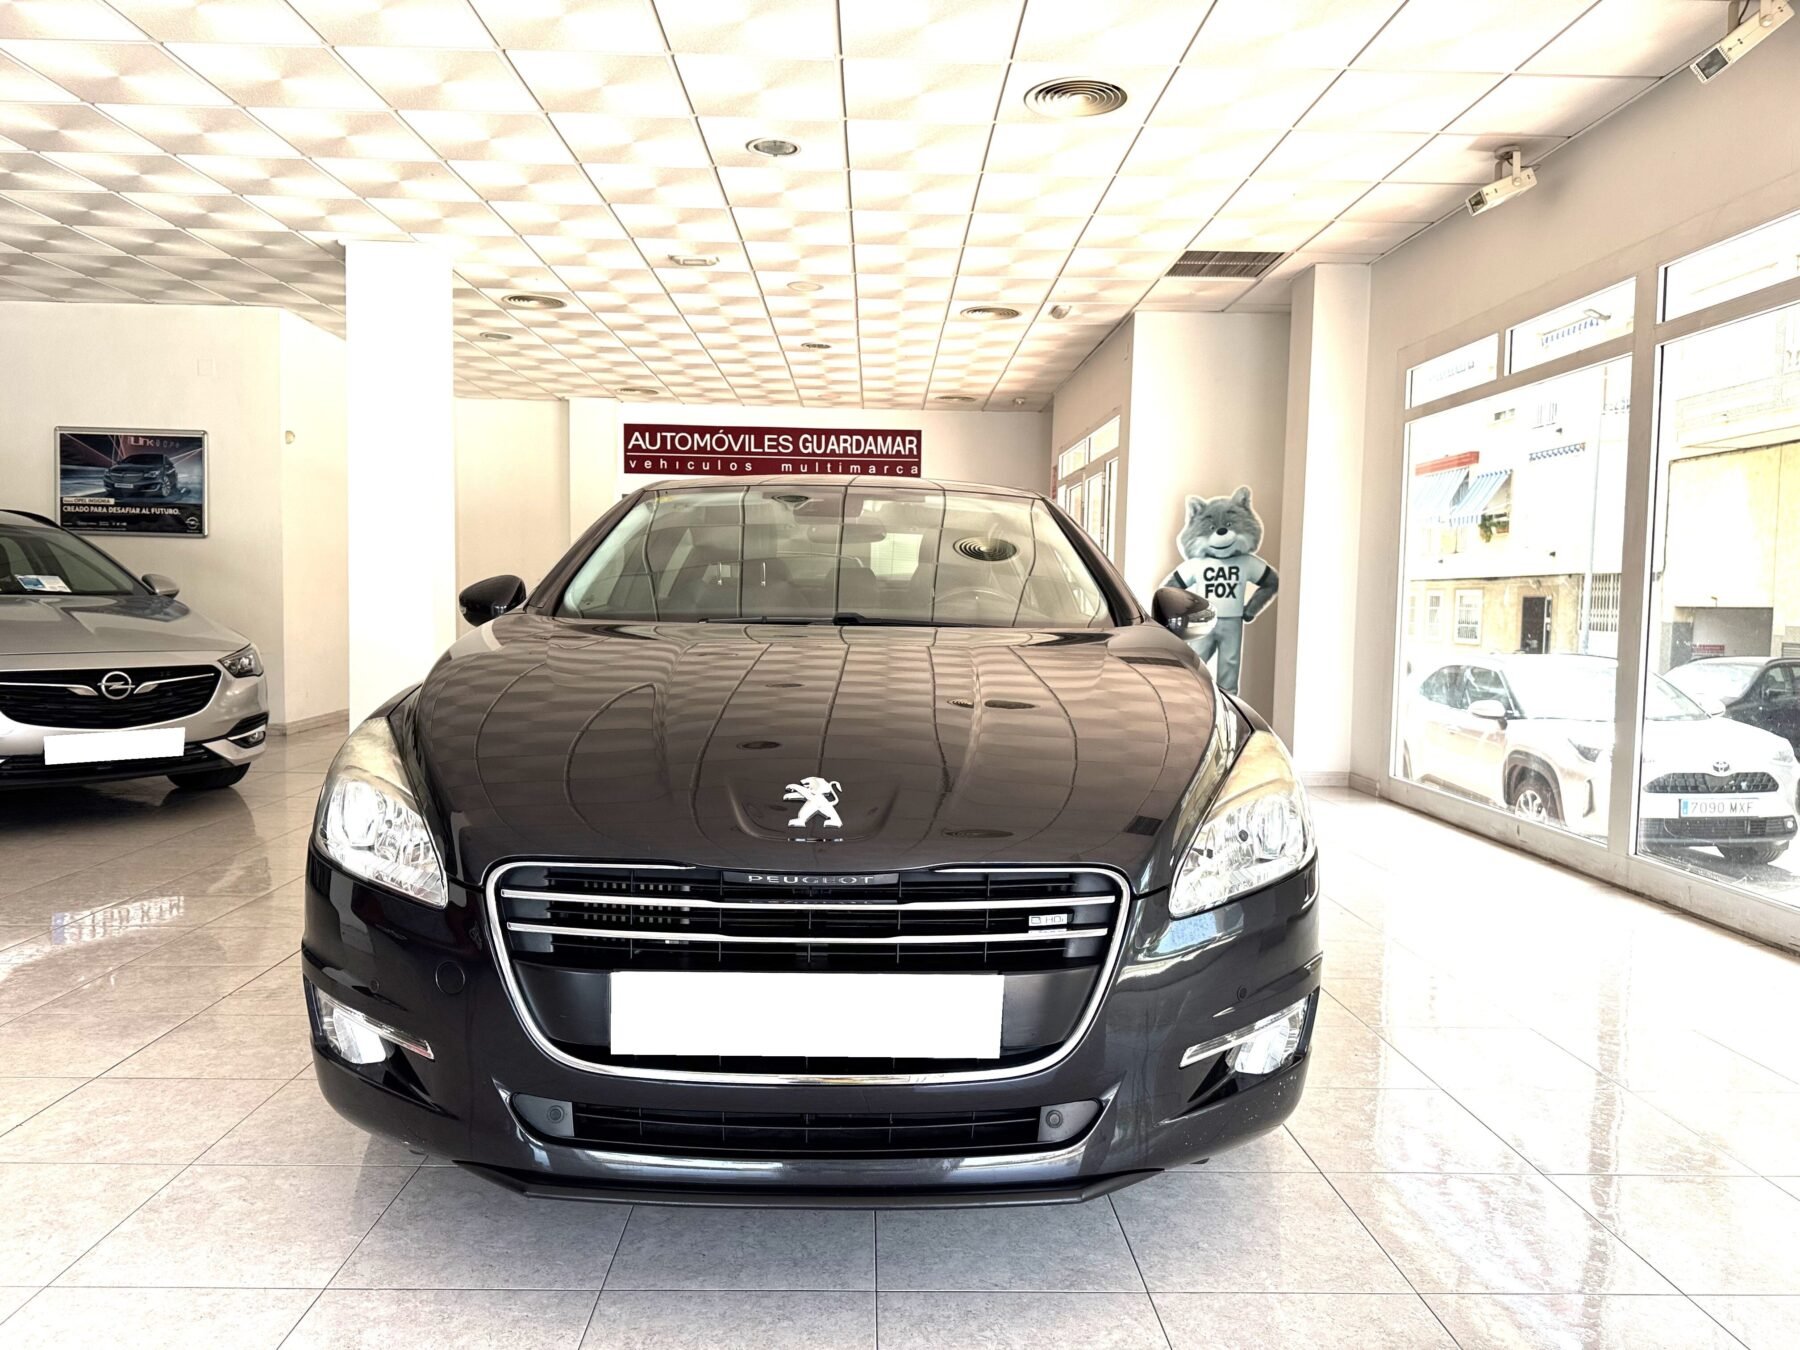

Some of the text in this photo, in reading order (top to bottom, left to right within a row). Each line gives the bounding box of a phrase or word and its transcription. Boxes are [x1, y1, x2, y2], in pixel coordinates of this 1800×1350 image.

[627, 429, 918, 455] AUTOMÓVILES GUARDAMAR
[781, 461, 918, 474] multimarca
[108, 506, 140, 514] DESAFIAR
[1203, 566, 1240, 581] CAR
[1204, 582, 1237, 598] FOX
[1691, 801, 1754, 814] 7090 MXF
[748, 875, 874, 884] PEUGEOT
